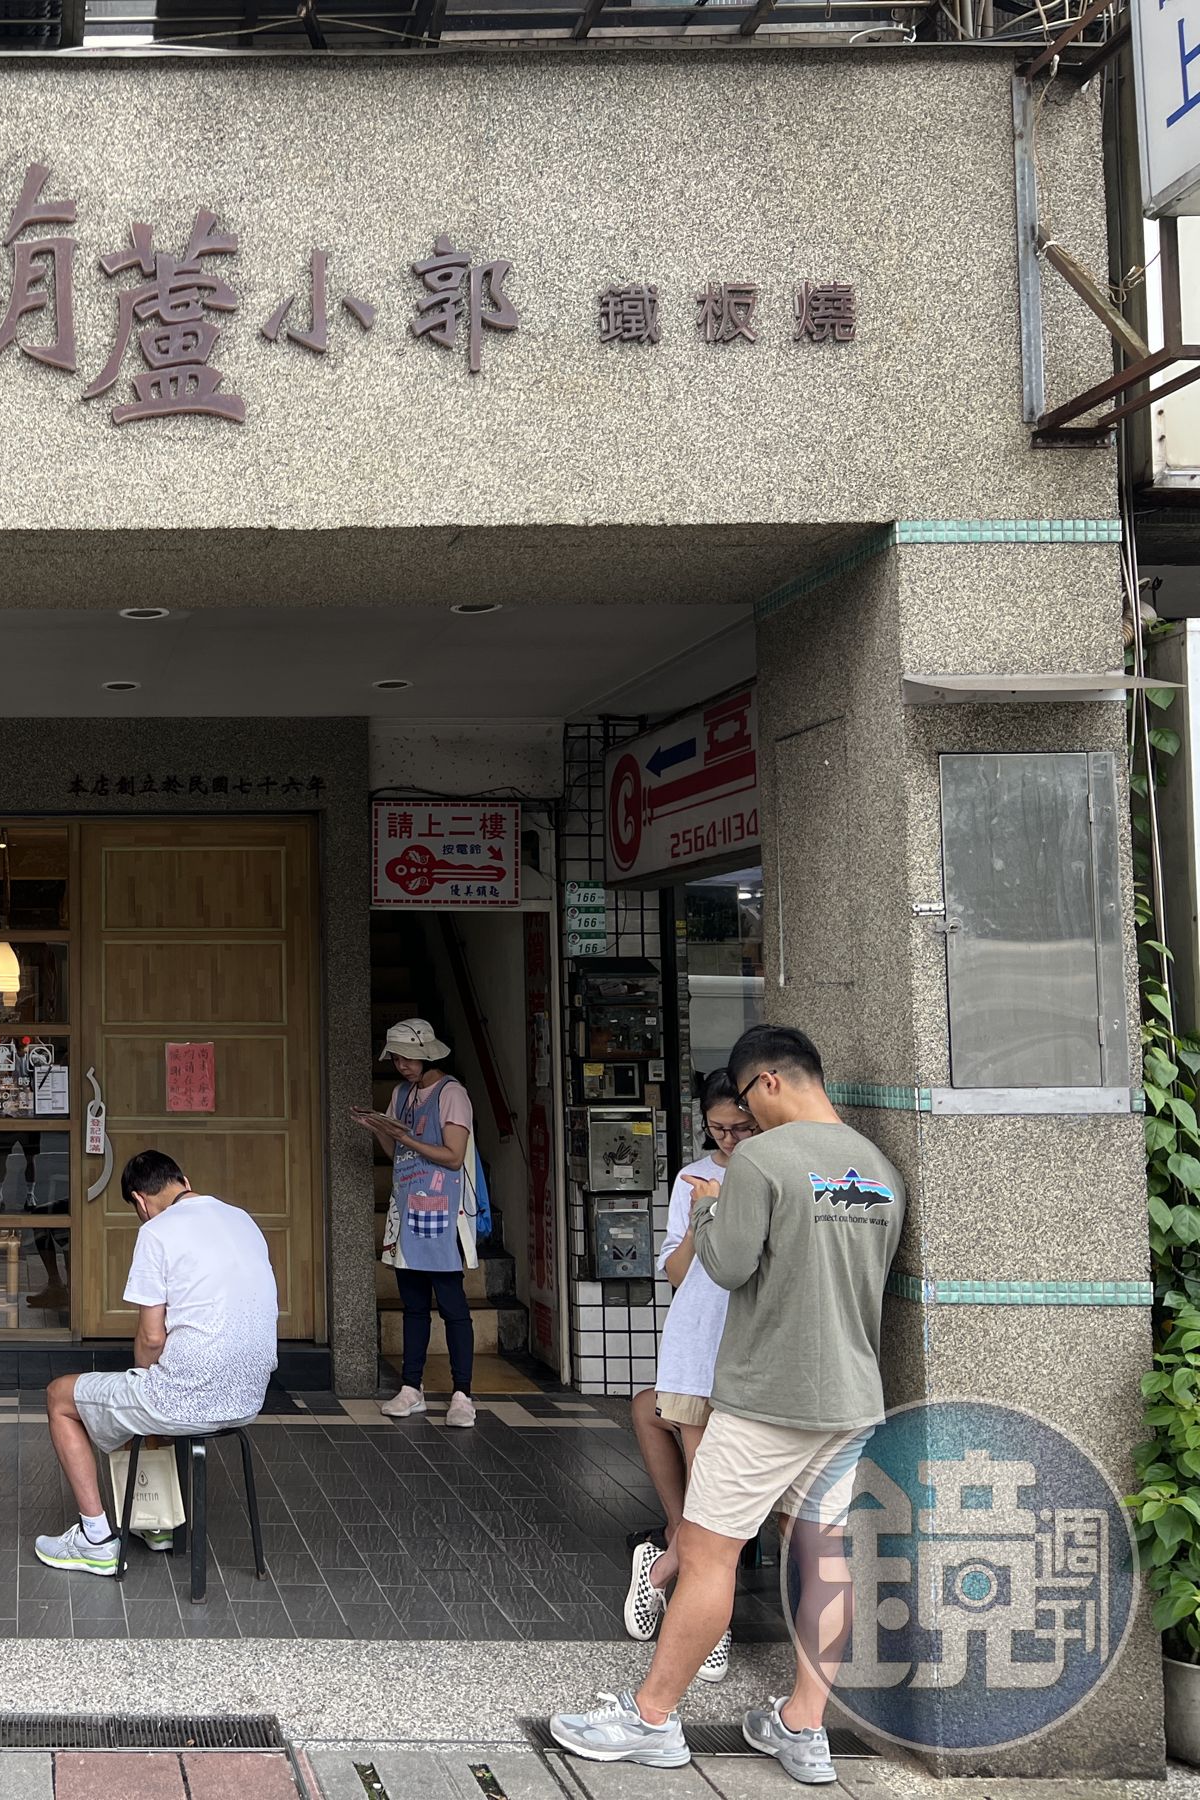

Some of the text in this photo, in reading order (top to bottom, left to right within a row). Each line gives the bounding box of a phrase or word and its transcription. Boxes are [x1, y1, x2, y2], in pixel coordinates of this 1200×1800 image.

[599, 281, 857, 343] 鐵板燒
[387, 811, 507, 840] 請上二樓
[670, 808, 759, 859] 2564-1134
[442, 844, 482, 856] 按電鈴
[577, 892, 597, 903] 166
[577, 917, 597, 928] 166
[578, 943, 598, 953] 166
